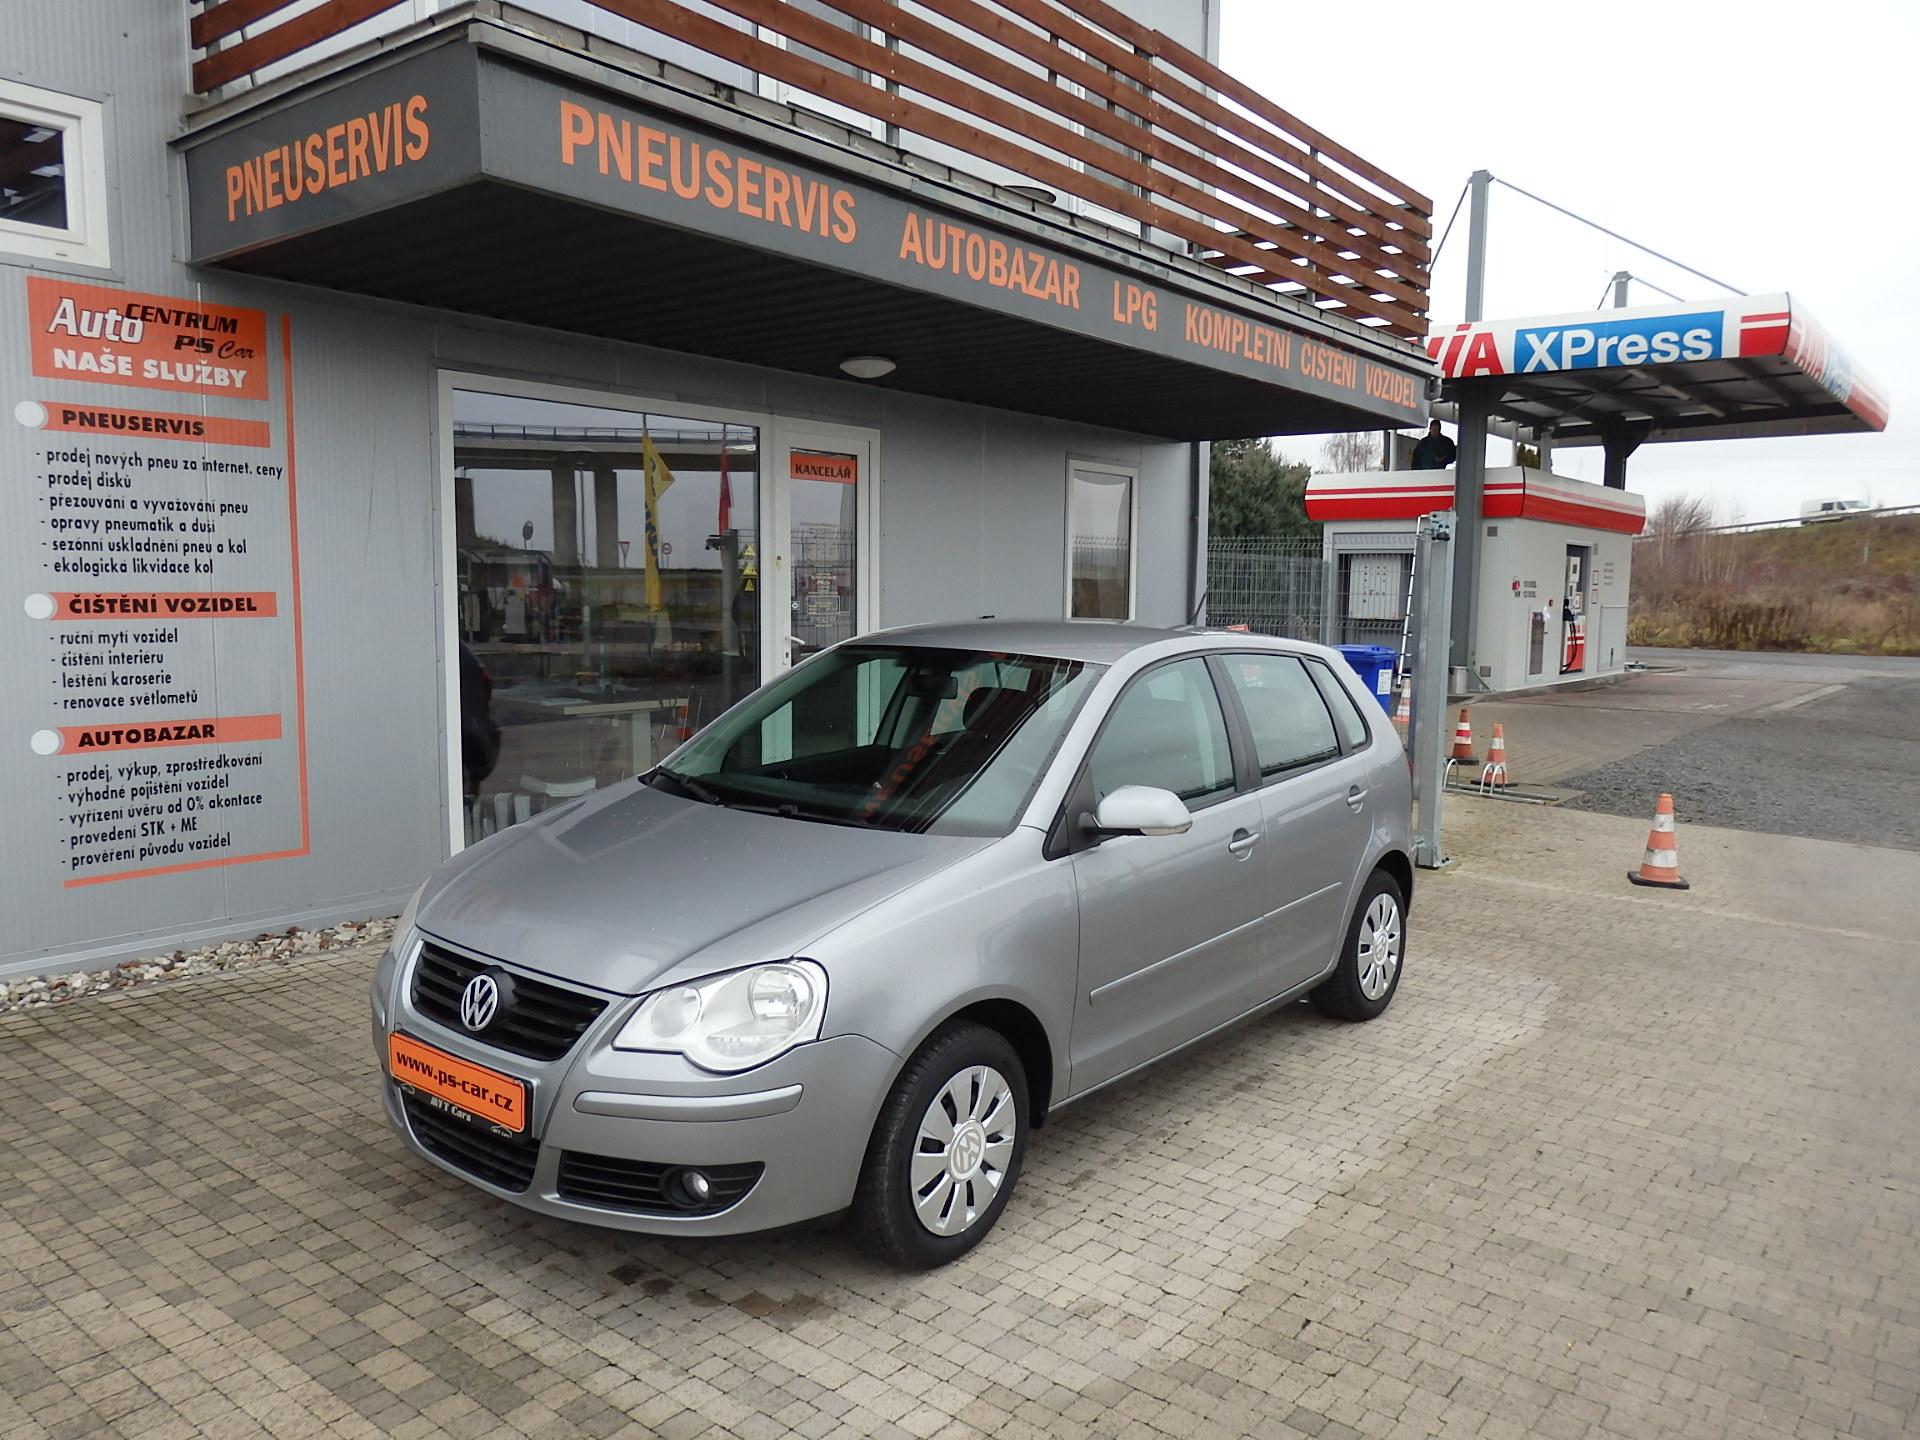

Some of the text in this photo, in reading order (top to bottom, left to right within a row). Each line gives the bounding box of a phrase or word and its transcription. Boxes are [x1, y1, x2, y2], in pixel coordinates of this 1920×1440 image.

[225, 94, 430, 222] PNEUSERVIS
[560, 99, 1417, 409] PNEUSERVIS AUTOBAZAR LPG KOMPLETNÍ ČIŠTĚNÍ VOZIDEL
[47, 296, 239, 344] Auto CENTRUM
[173, 334, 258, 360] PS Car
[1523, 328, 1713, 373] XPress
[53, 346, 248, 388] NAŠE SLUŽBY
[62, 408, 205, 436] PNEUSERVIS
[47, 447, 283, 480] prodej nových pneu za internet. ceny
[795, 462, 852, 480] KANCELÁŘ
[48, 469, 132, 491] prodej disků
[49, 493, 249, 517] přezouvání a vyvažování pneu
[50, 516, 216, 534] opravy pneumatik a duší
[52, 536, 247, 557] sezónní uskladnění pneu a kol
[54, 556, 214, 577] ekologická likvidace kol
[68, 593, 258, 614] ČIŠTĚNÍ VOZIDEL
[60, 630, 93, 645] ruční
[133, 627, 178, 643] vozidel
[61, 649, 164, 667] čištění interiéru
[62, 669, 172, 688] leštění karoserie
[63, 689, 199, 709] renovace světlometů
[78, 724, 216, 747] AUTOBAZAR
[67, 752, 263, 786] prodej, výkup, zprostředkování
[68, 773, 229, 807] výhodné pojištění vozidel
[167, 798, 182, 814] od
[186, 795, 205, 812] 0%
[208, 794, 263, 810] akontace
[70, 816, 197, 850] provedení STK + ME
[71, 832, 231, 871] prověření původu vozidel
[396, 1051, 513, 1112] www.ps-car.cz
